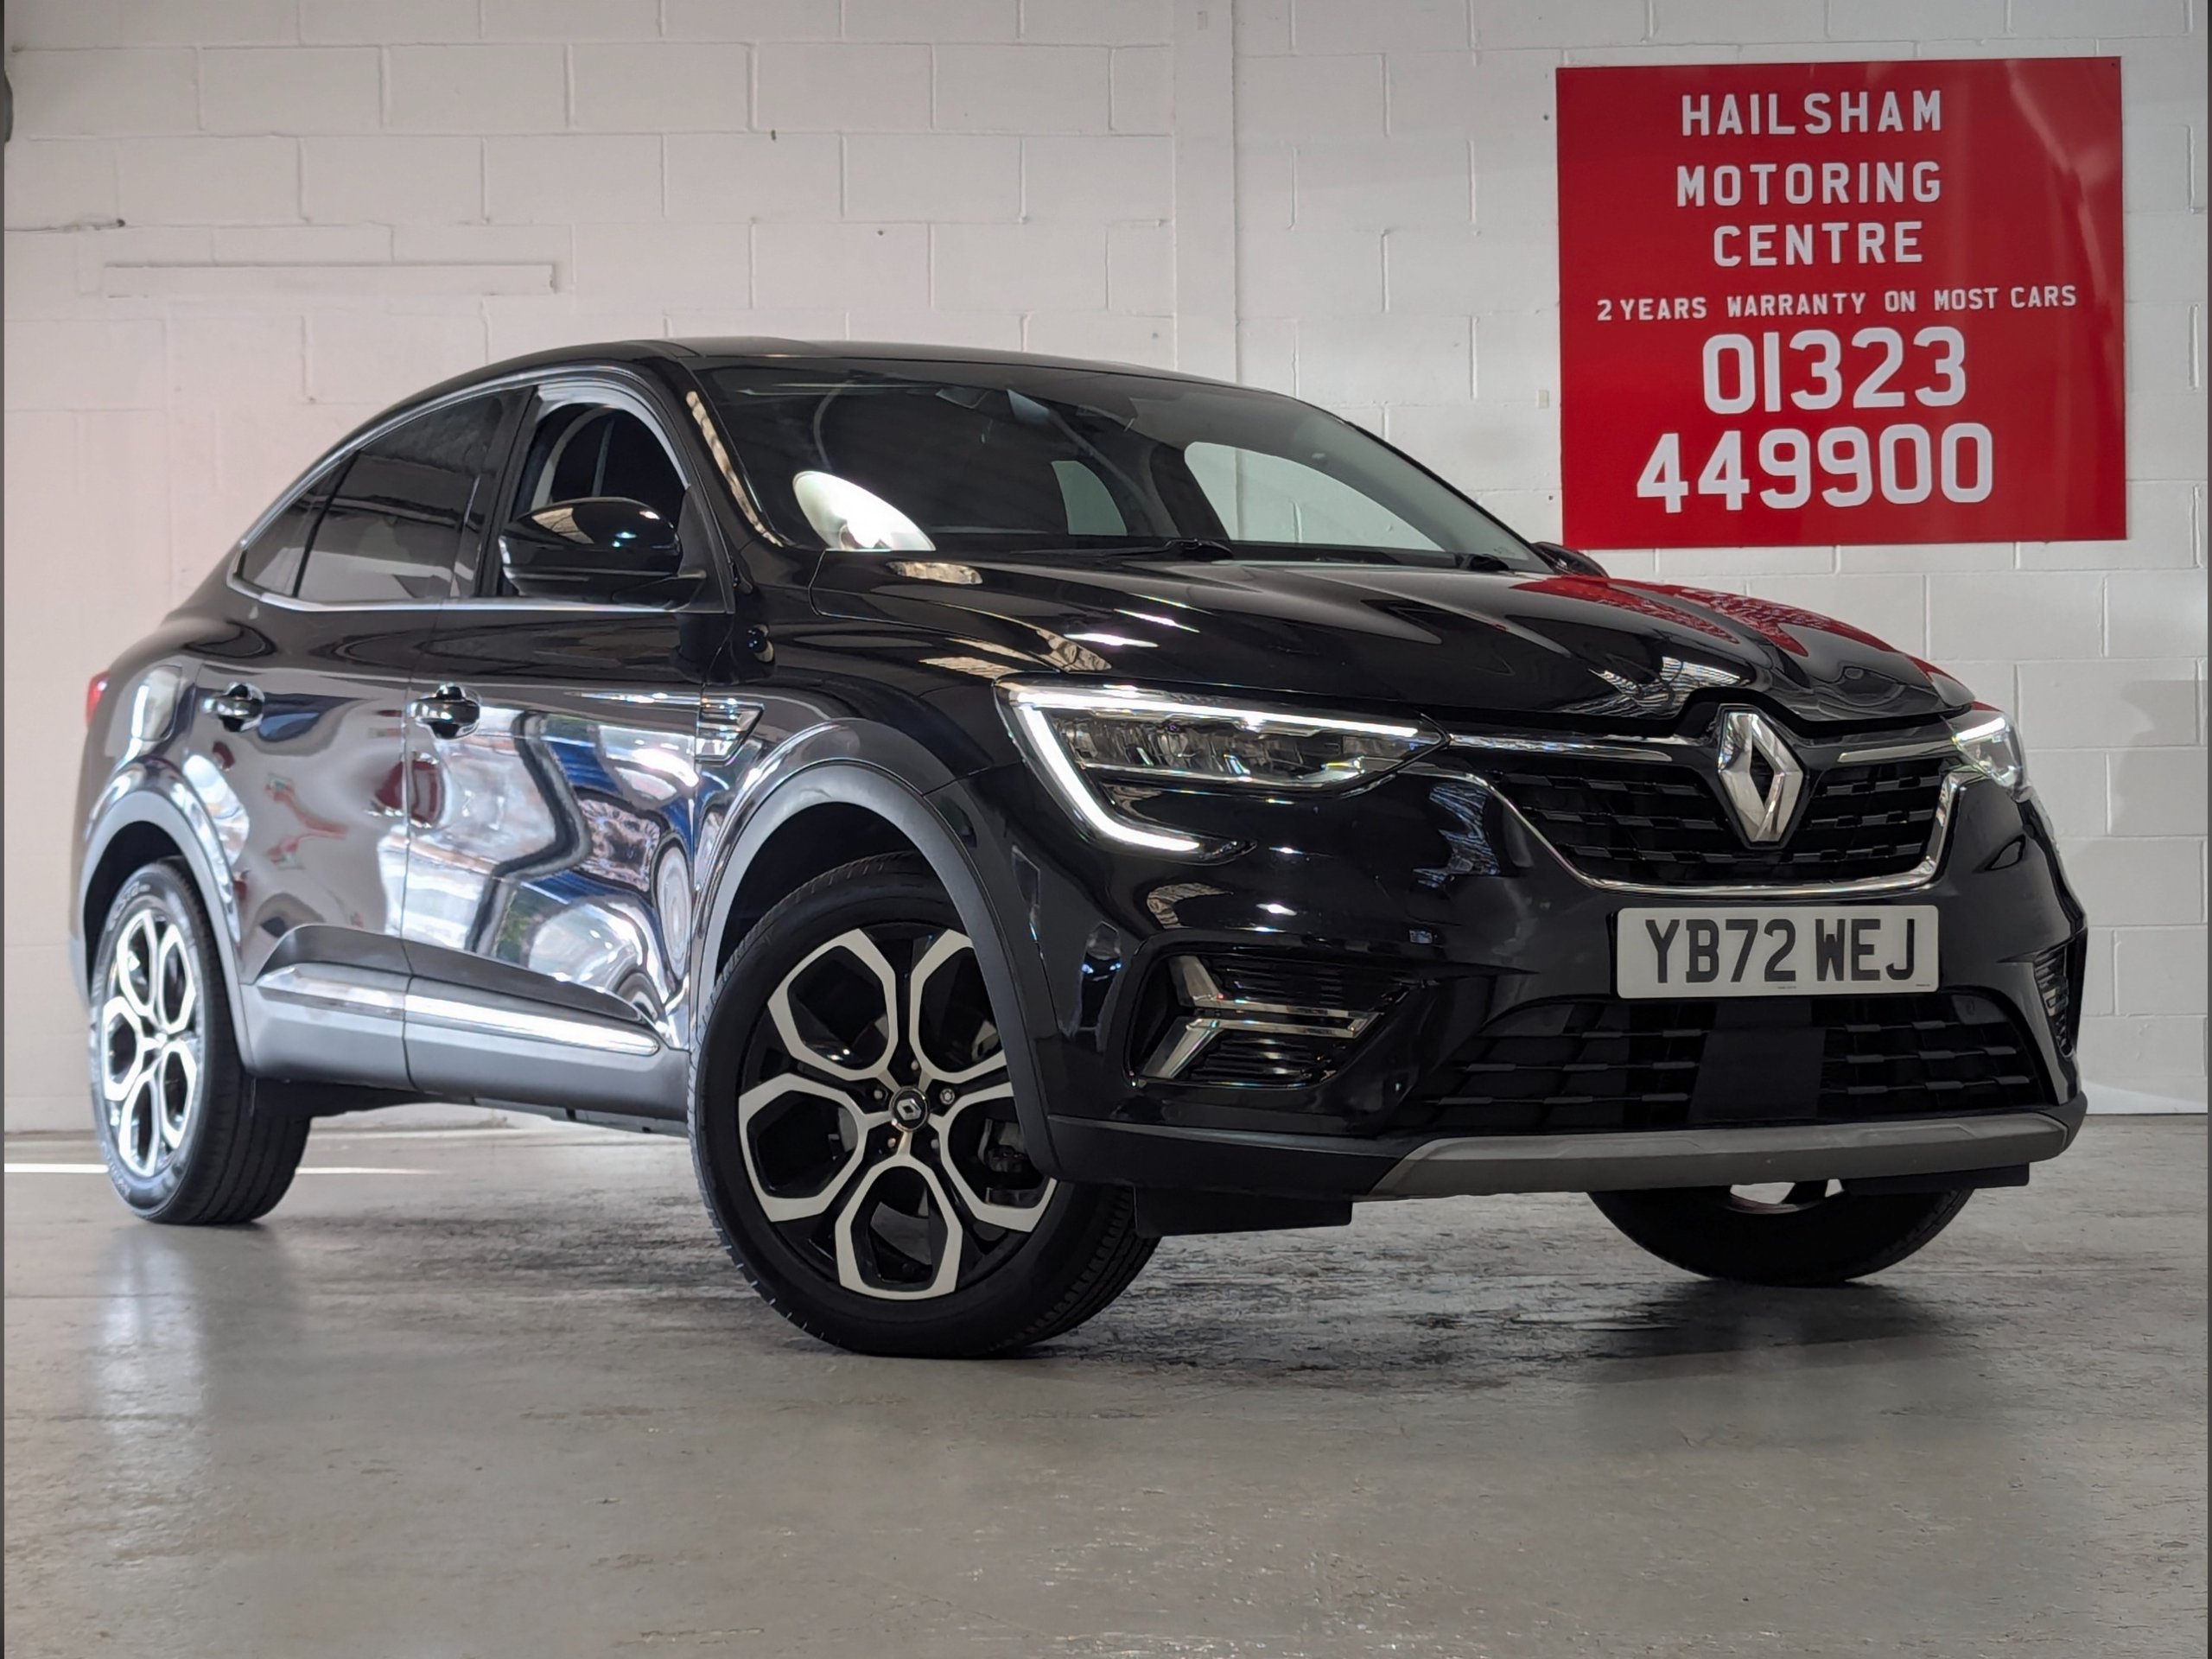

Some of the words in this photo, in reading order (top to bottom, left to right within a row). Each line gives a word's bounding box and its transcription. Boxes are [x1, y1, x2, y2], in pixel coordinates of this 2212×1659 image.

[1682, 90, 1941, 136] HAILSHAM
[1677, 161, 1941, 207] MOTORING
[1713, 221, 1923, 267] CENTRE
[1597, 299, 1612, 321] 2
[1620, 296, 1707, 321] YEARS
[1727, 292, 1866, 317] WARRANTY
[1885, 291, 1916, 312] ON
[1934, 288, 1998, 311] MOST
[2011, 286, 2076, 308] CARS
[1702, 326, 1967, 415] 01323
[1637, 423, 1993, 513] 449900
[1645, 918, 1796, 983] YB72
[1815, 918, 1915, 982] WEJ
